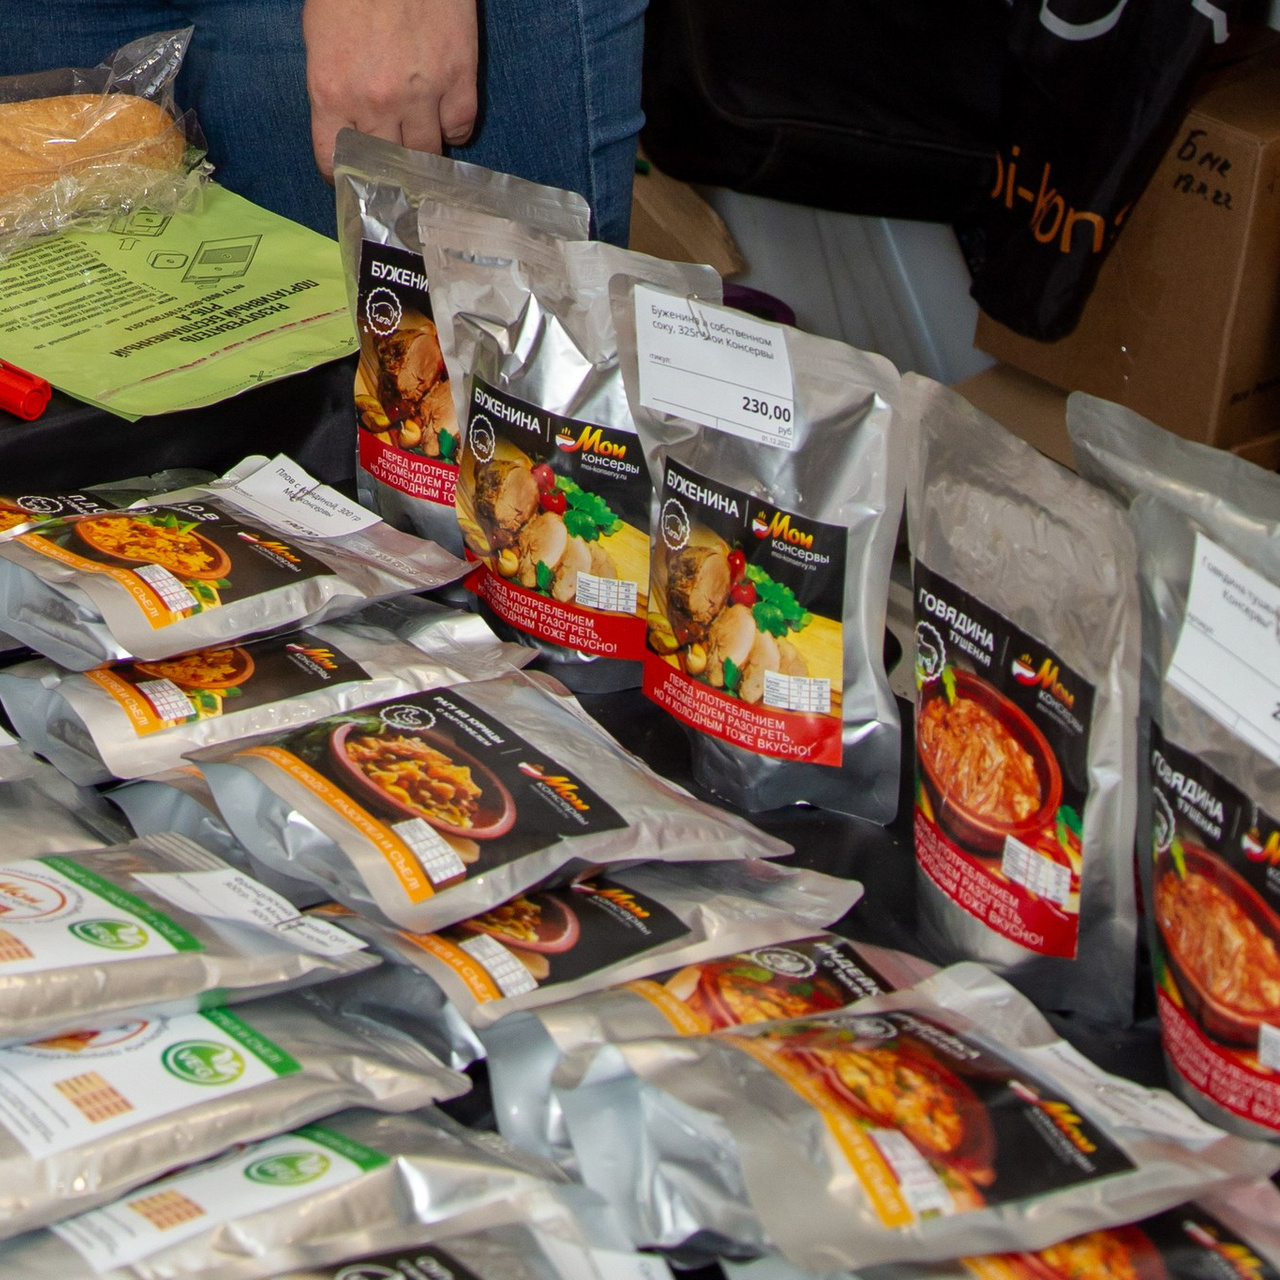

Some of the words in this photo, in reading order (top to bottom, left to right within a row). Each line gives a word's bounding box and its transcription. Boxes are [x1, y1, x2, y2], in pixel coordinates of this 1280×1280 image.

[371, 261, 430, 293] БУЖЕНИ
[175, 301, 221, 323] РПБ-А
[221, 278, 320, 320] ПОРТАТИВНЫЙ
[109, 306, 225, 359] БЕСПЛАМЕННЫЙ
[178, 302, 290, 345] РАЗОГРЕВАТЕЛЬ
[650, 304, 700, 326] Буженина
[709, 320, 773, 347] собственном
[652, 319, 676, 335] соку,
[725, 338, 775, 360] Консервы
[649, 352, 672, 363] тикул:
[473, 386, 542, 435] БУЖЕНИНА
[742, 395, 792, 423] 230,00
[576, 425, 628, 459] Мои
[761, 434, 791, 449] 01.12.2022
[777, 426, 793, 436] руб
[377, 456, 442, 490] РЕКОМЕНДУЕМ
[382, 448, 409, 469] ПЕРЕД
[408, 457, 460, 483] УПОТРЕБ
[581, 452, 640, 475] консервы
[274, 467, 295, 487] Плов
[338, 506, 354, 521] 300
[370, 464, 380, 477] НО
[387, 471, 440, 503] ХОЛОДНЫМ
[441, 489, 457, 504] ТО
[666, 468, 740, 519] БУЖЕНИНА
[767, 511, 814, 549] Мои
[253, 542, 302, 573] консервы
[771, 539, 831, 564] консервы
[132, 585, 160, 620] СЪЕЛ!
[509, 589, 596, 628] УПОТРЕБЛЕНИЕМ
[919, 587, 995, 652] ГОВЯДИНА
[537, 622, 567, 642] ТОЖЕ
[568, 634, 618, 654] ВКУСНО!
[540, 613, 603, 641] РАЗОГРЕТЬ,
[949, 629, 992, 668] ТУШЕНАЯ
[432, 695, 456, 713] РАГУ
[663, 680, 726, 722] РЕКОМЕНДУЕМ
[727, 715, 795, 744] РАЗОГРЕТЬ,
[670, 672, 695, 697] ПЕРЕД
[695, 689, 786, 731] УПОТРЕБЛЕНИЕМ
[653, 686, 665, 701] НО
[671, 699, 723, 733] ХОЛОДНЫМ
[725, 726, 755, 747] ТОЖЕ
[757, 738, 813, 758] ВКУСНО!
[535, 781, 590, 826] консервы
[1152, 749, 1225, 824] ГОВЯДИНА
[1176, 796, 1222, 841] ТУШЕНАЯ
[388, 847, 422, 891] СЪЕЛ!
[957, 889, 988, 918] ТОЖЕ
[987, 910, 1044, 947] ВКУСНО!
[960, 874, 1027, 928] РАЗОГРЕТЬ,
[178, 1049, 215, 1079] VEG
